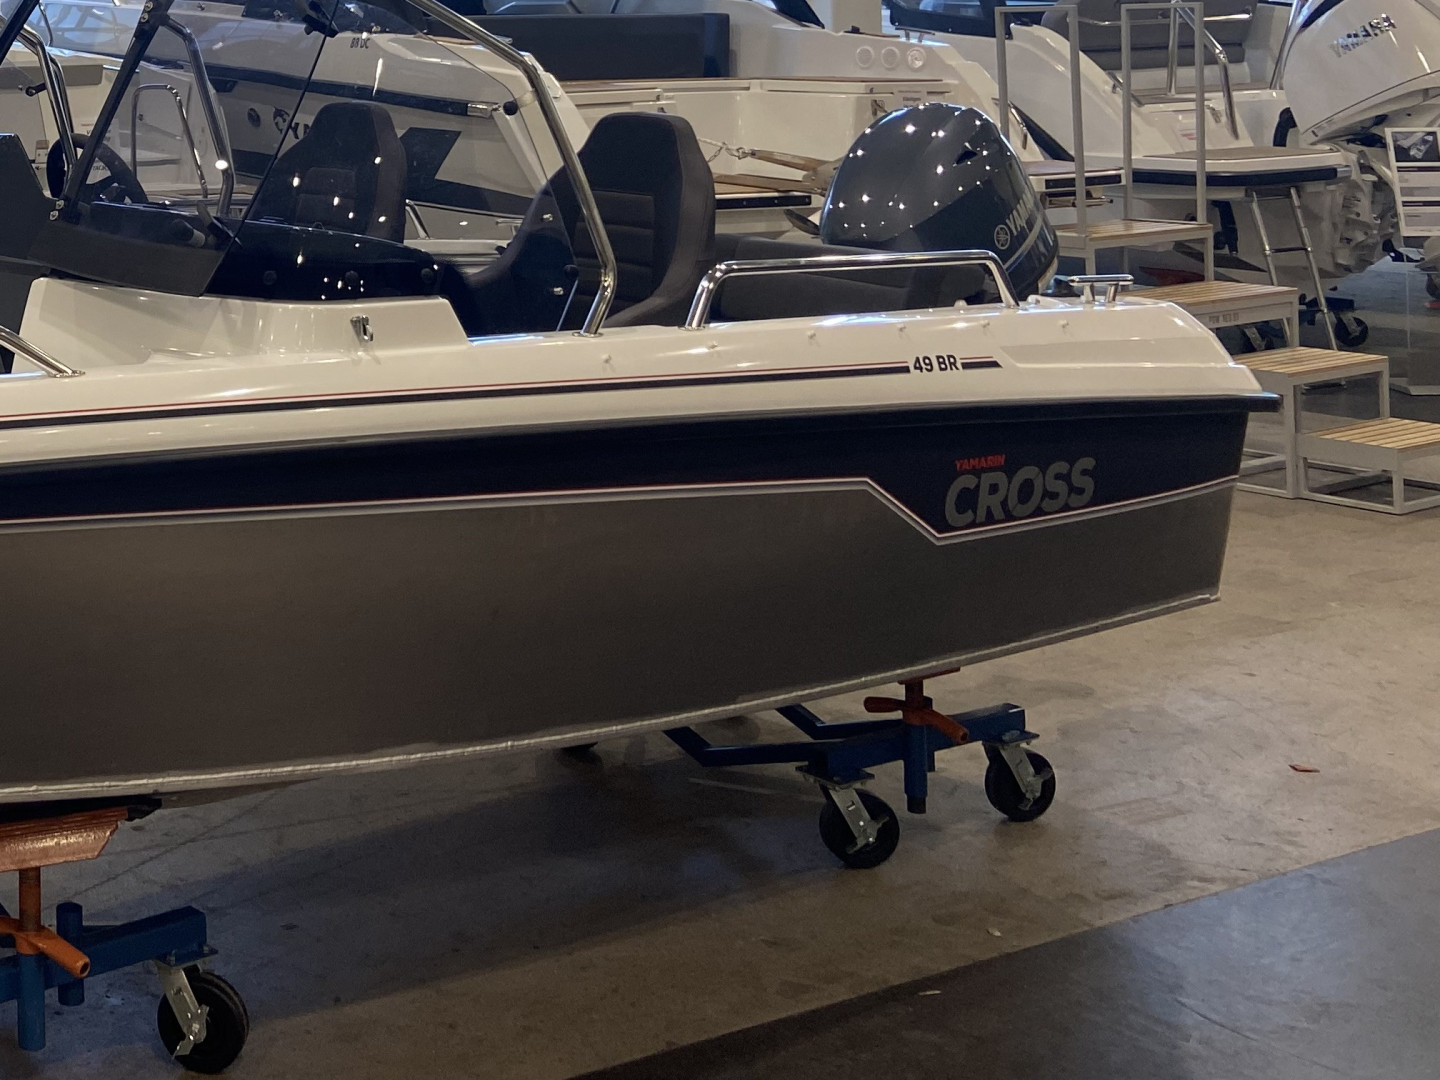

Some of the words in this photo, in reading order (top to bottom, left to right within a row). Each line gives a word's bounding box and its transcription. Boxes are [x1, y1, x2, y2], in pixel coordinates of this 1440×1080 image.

[1328, 12, 1398, 59] YAMAHA
[913, 356, 933, 373] 49
[936, 355, 960, 372] BR
[955, 454, 1006, 471] YAMARIN
[944, 456, 1097, 527] CROSS
